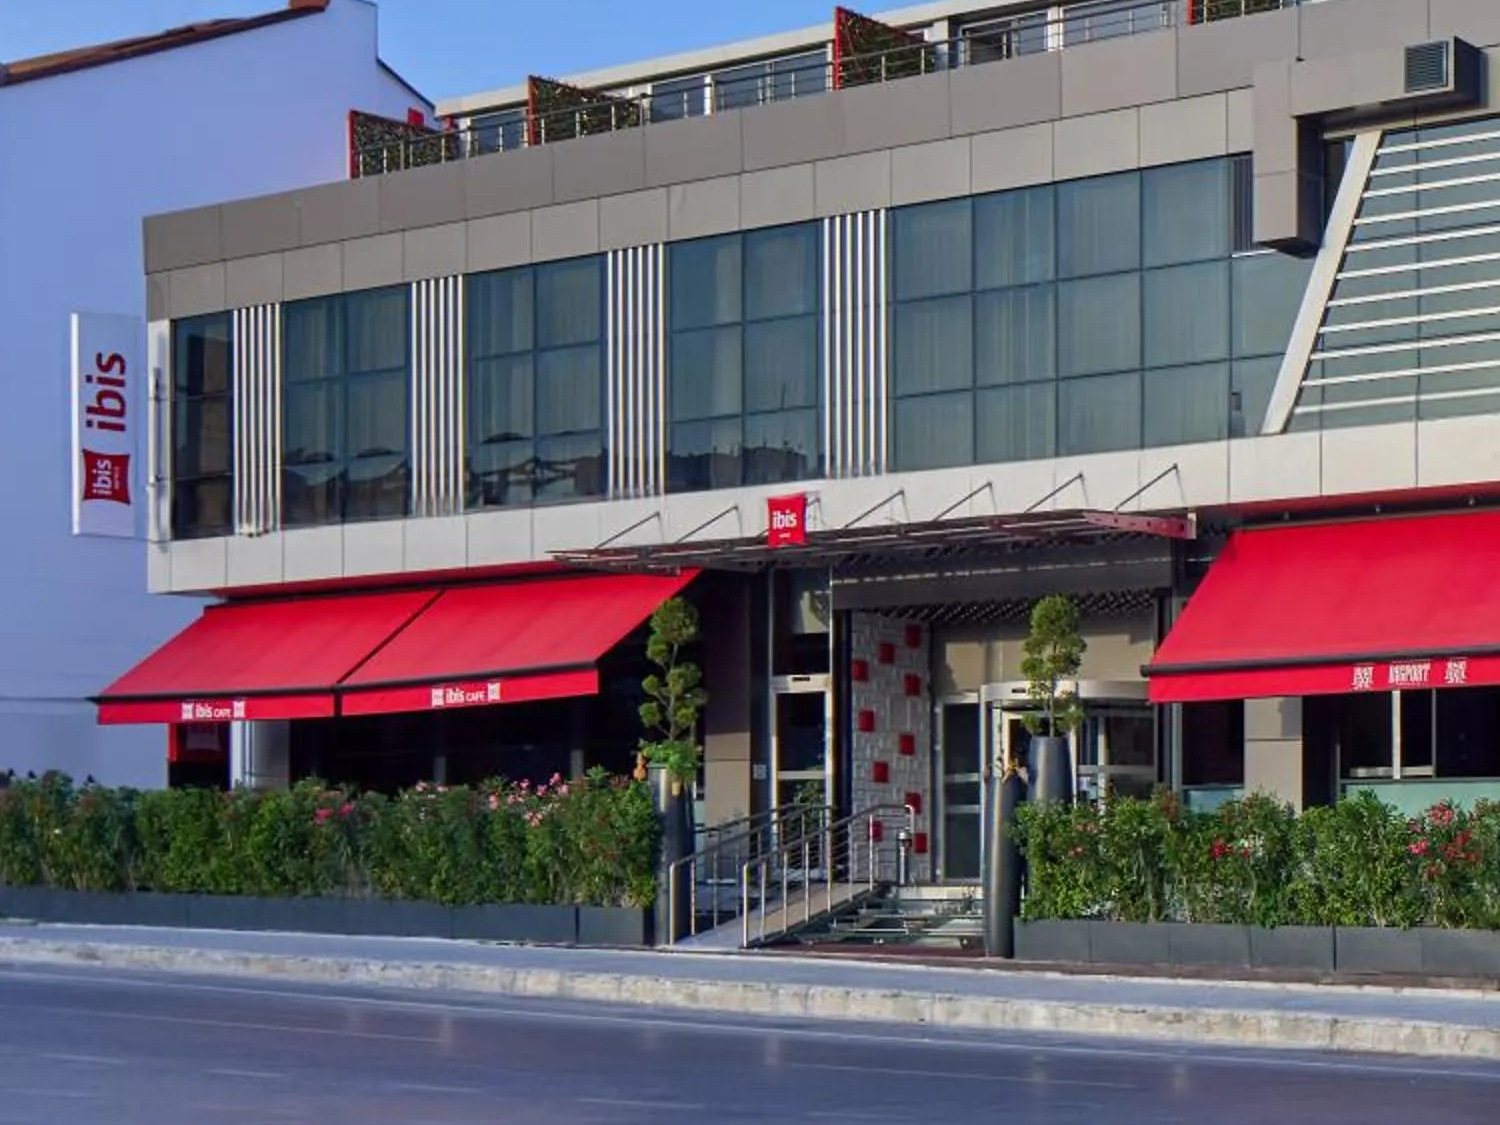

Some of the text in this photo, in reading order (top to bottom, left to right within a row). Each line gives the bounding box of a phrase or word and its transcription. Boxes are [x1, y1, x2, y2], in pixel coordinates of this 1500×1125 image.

[85, 351, 127, 432] ibis
[91, 458, 112, 495] ibis
[772, 508, 797, 530] ibis
